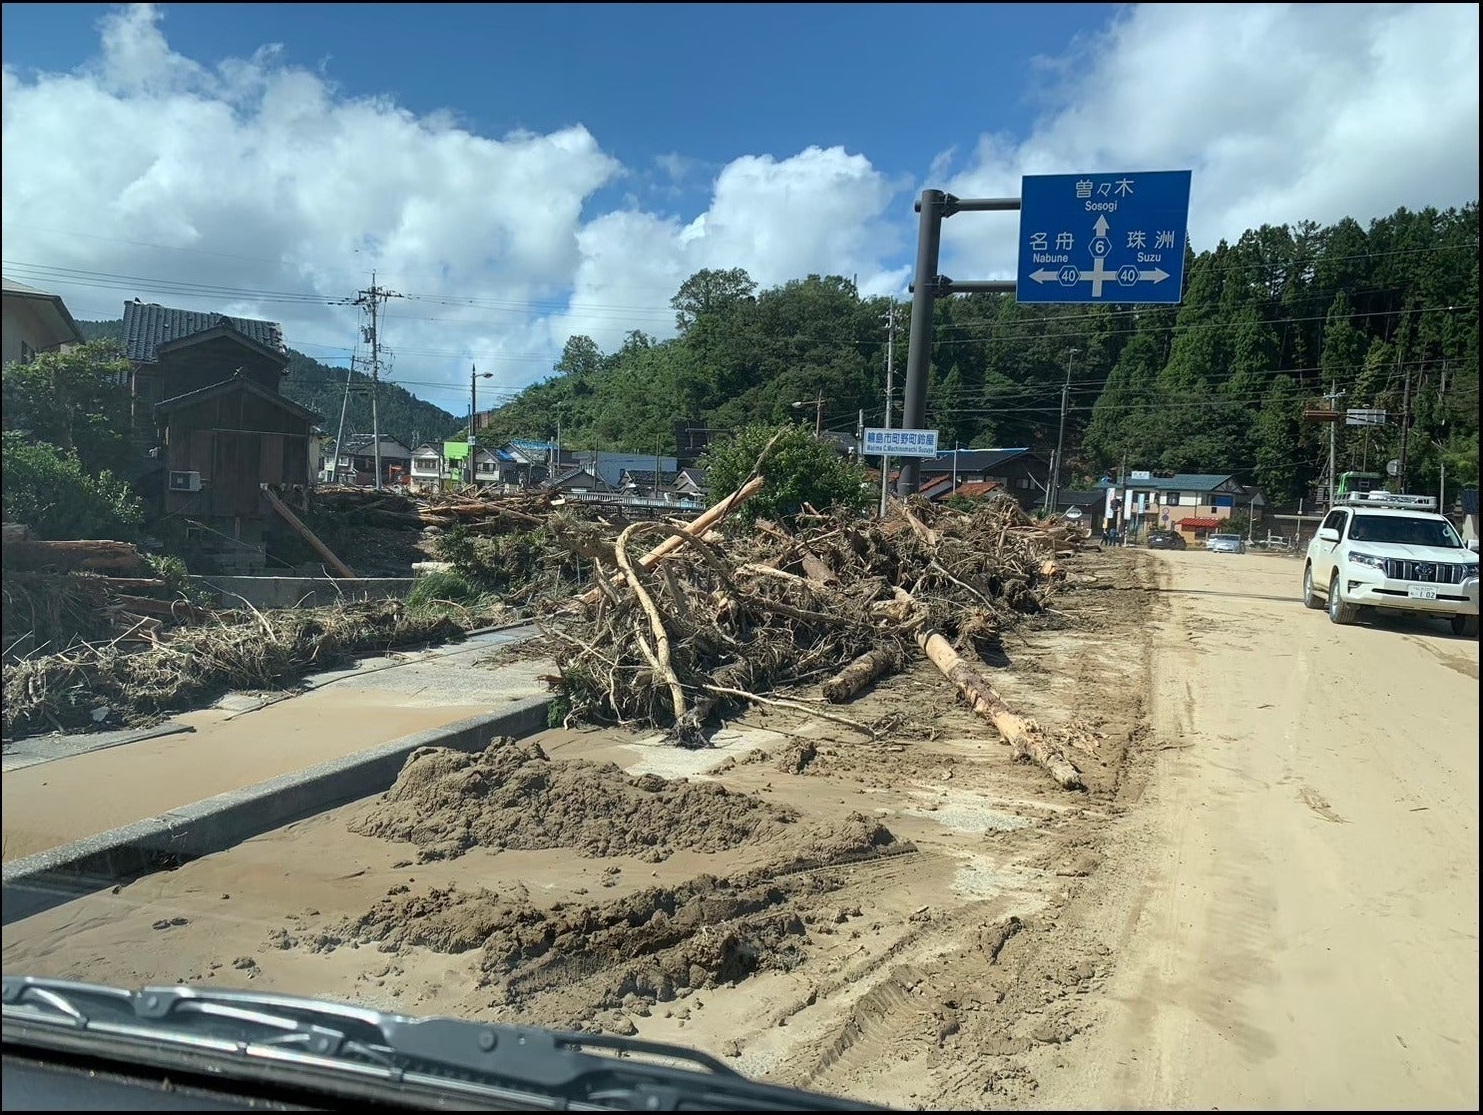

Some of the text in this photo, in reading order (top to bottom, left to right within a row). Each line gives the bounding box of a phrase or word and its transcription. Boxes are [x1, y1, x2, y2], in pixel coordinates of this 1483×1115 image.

[1085, 200, 1118, 213] Sosogi
[1029, 232, 1075, 251] 名舟
[1126, 230, 1175, 249] 珠洲
[1095, 240, 1105, 254] 6
[1032, 253, 1069, 263] Nabune
[1137, 252, 1162, 262] Suzu
[1061, 270, 1076, 282] 40
[1120, 270, 1135, 282] 40
